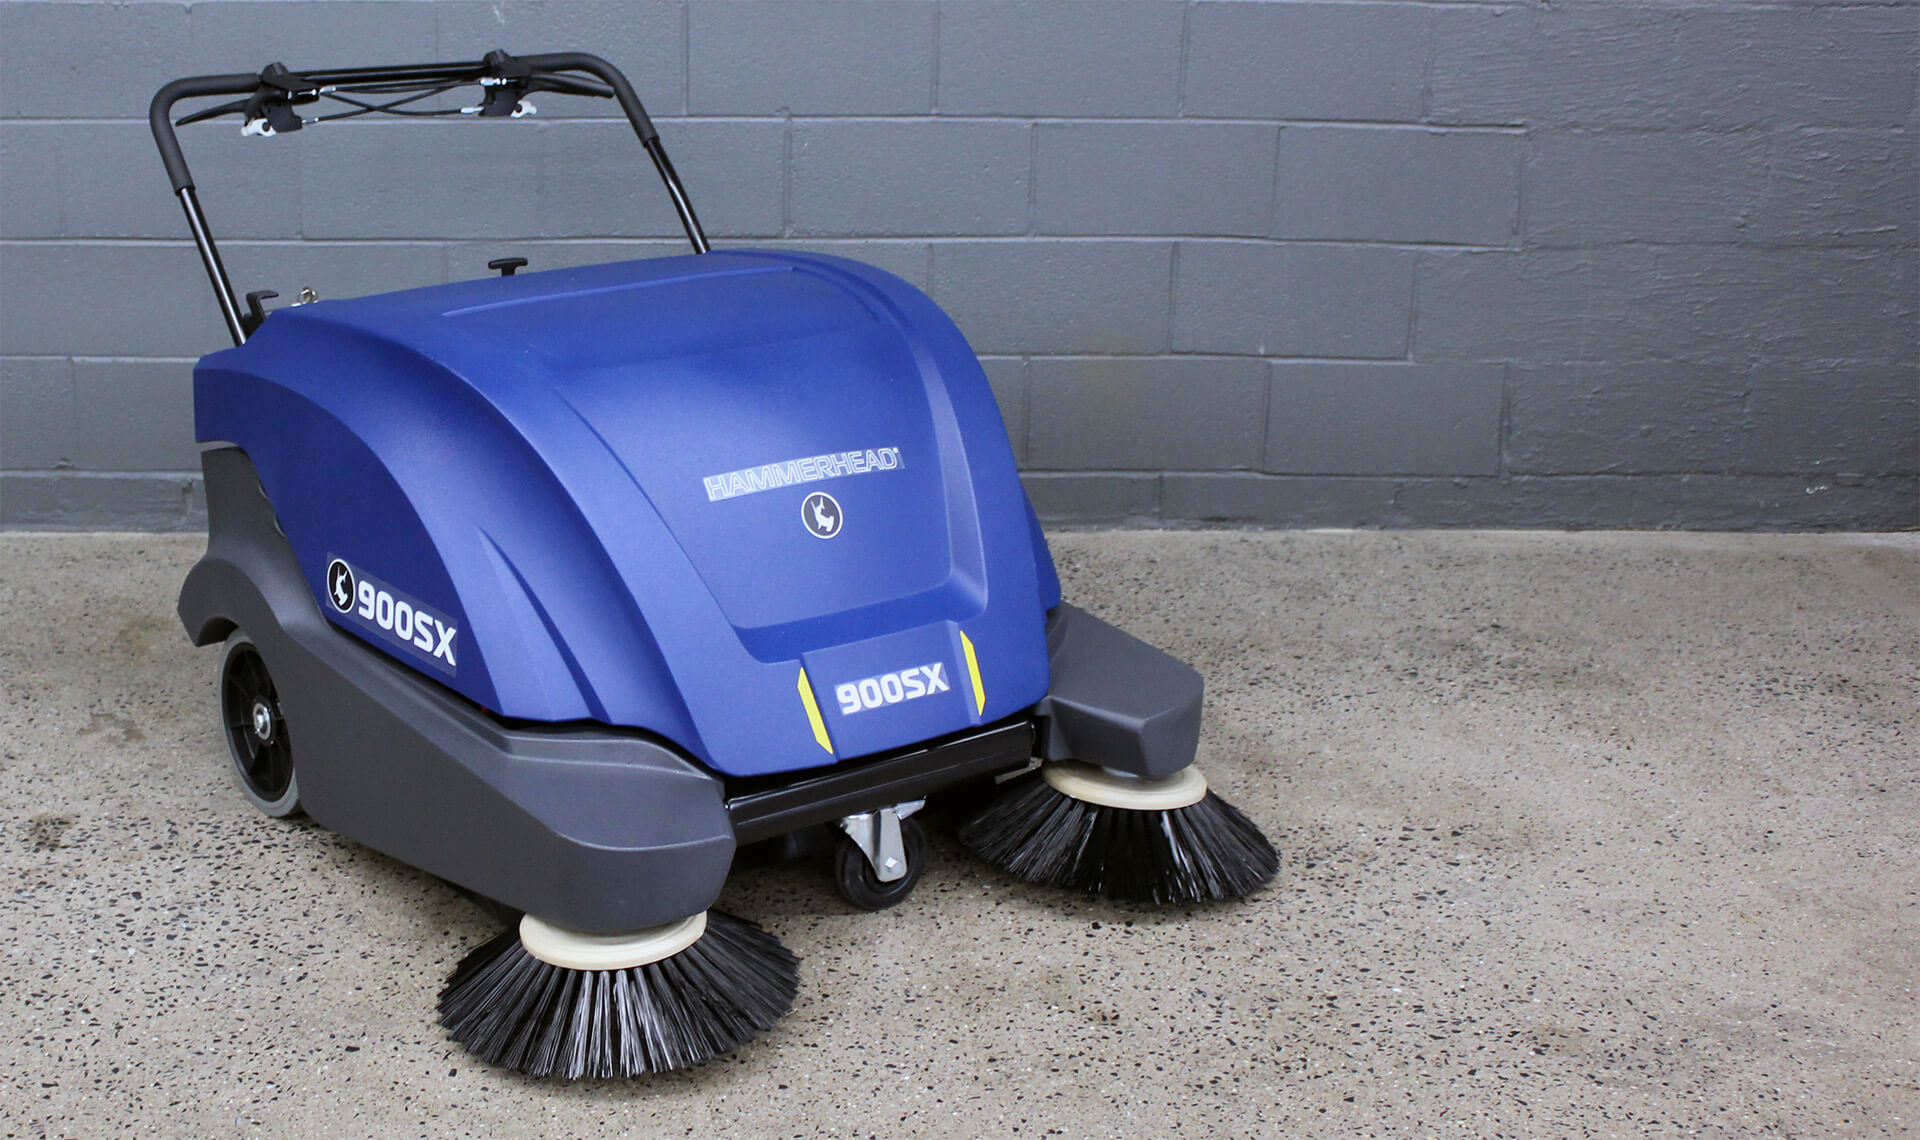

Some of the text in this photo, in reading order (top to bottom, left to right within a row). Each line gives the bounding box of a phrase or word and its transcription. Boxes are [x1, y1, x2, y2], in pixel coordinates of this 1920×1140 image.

[703, 447, 899, 500] HAMMERHEAD
[358, 580, 457, 666] 900SX
[836, 662, 949, 715] 900SX
